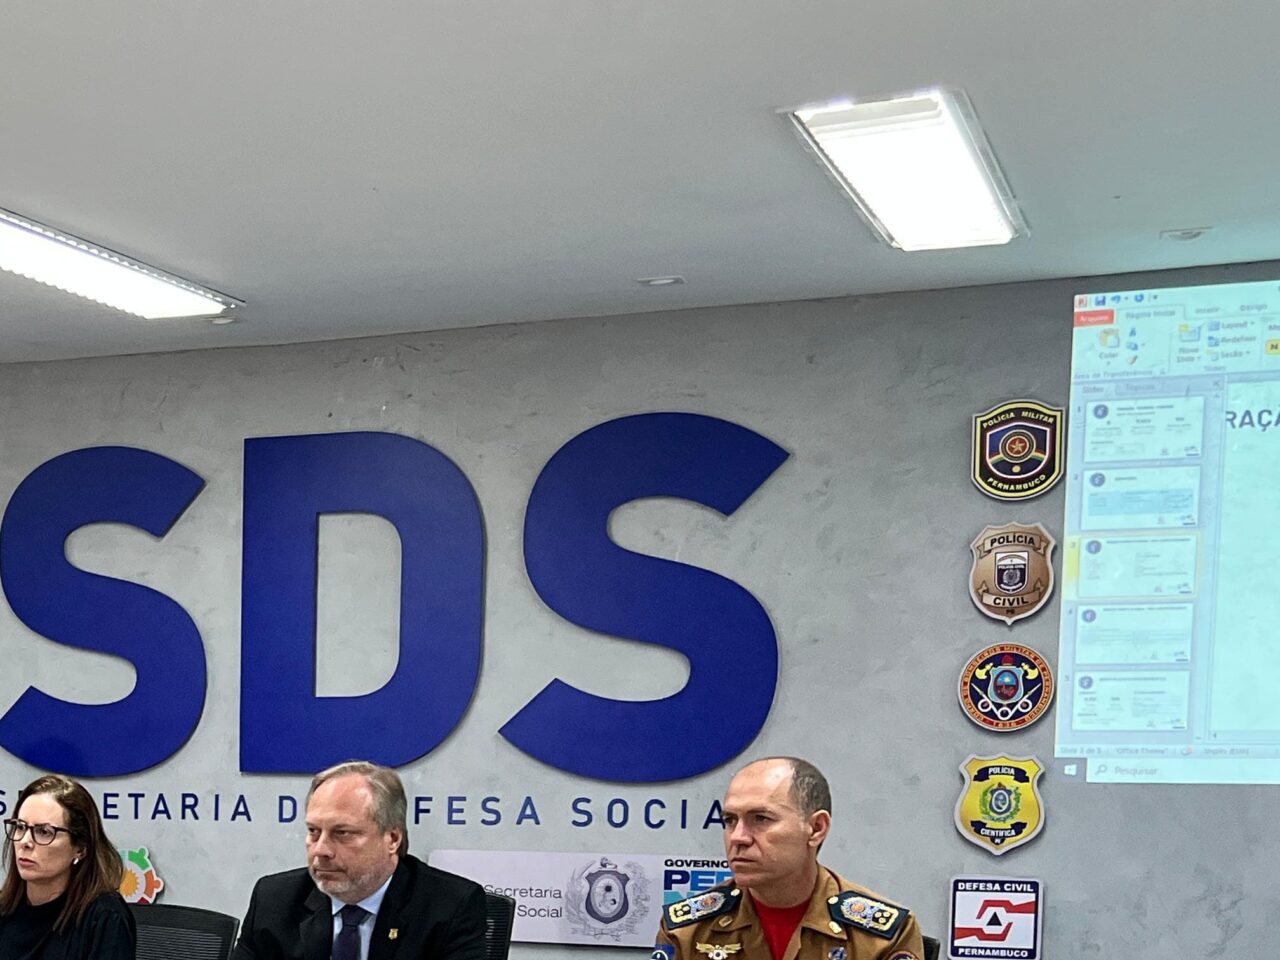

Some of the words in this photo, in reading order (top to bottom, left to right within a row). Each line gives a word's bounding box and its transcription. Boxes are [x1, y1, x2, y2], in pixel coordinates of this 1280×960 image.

[982, 411, 1016, 428] POLÍCIA
[1021, 411, 1055, 424] MILITAR
[987, 474, 1046, 491] PERNAMBUCO
[990, 532, 1035, 547] POLÍCIA
[993, 597, 1029, 606] CIVIL
[988, 765, 1015, 775] POLÍCIA
[1114, 765, 1158, 776] Pesquisar
[414, 795, 541, 825] FESA
[571, 797, 727, 829] SOCIA
[664, 859, 729, 868] GOVERNO
[484, 884, 562, 899] Secretaria
[958, 882, 1001, 891] DEFESA
[1004, 883, 1034, 892] CIVIL
[516, 905, 563, 918] Social
[958, 947, 1028, 957] PERNAMBUCO
